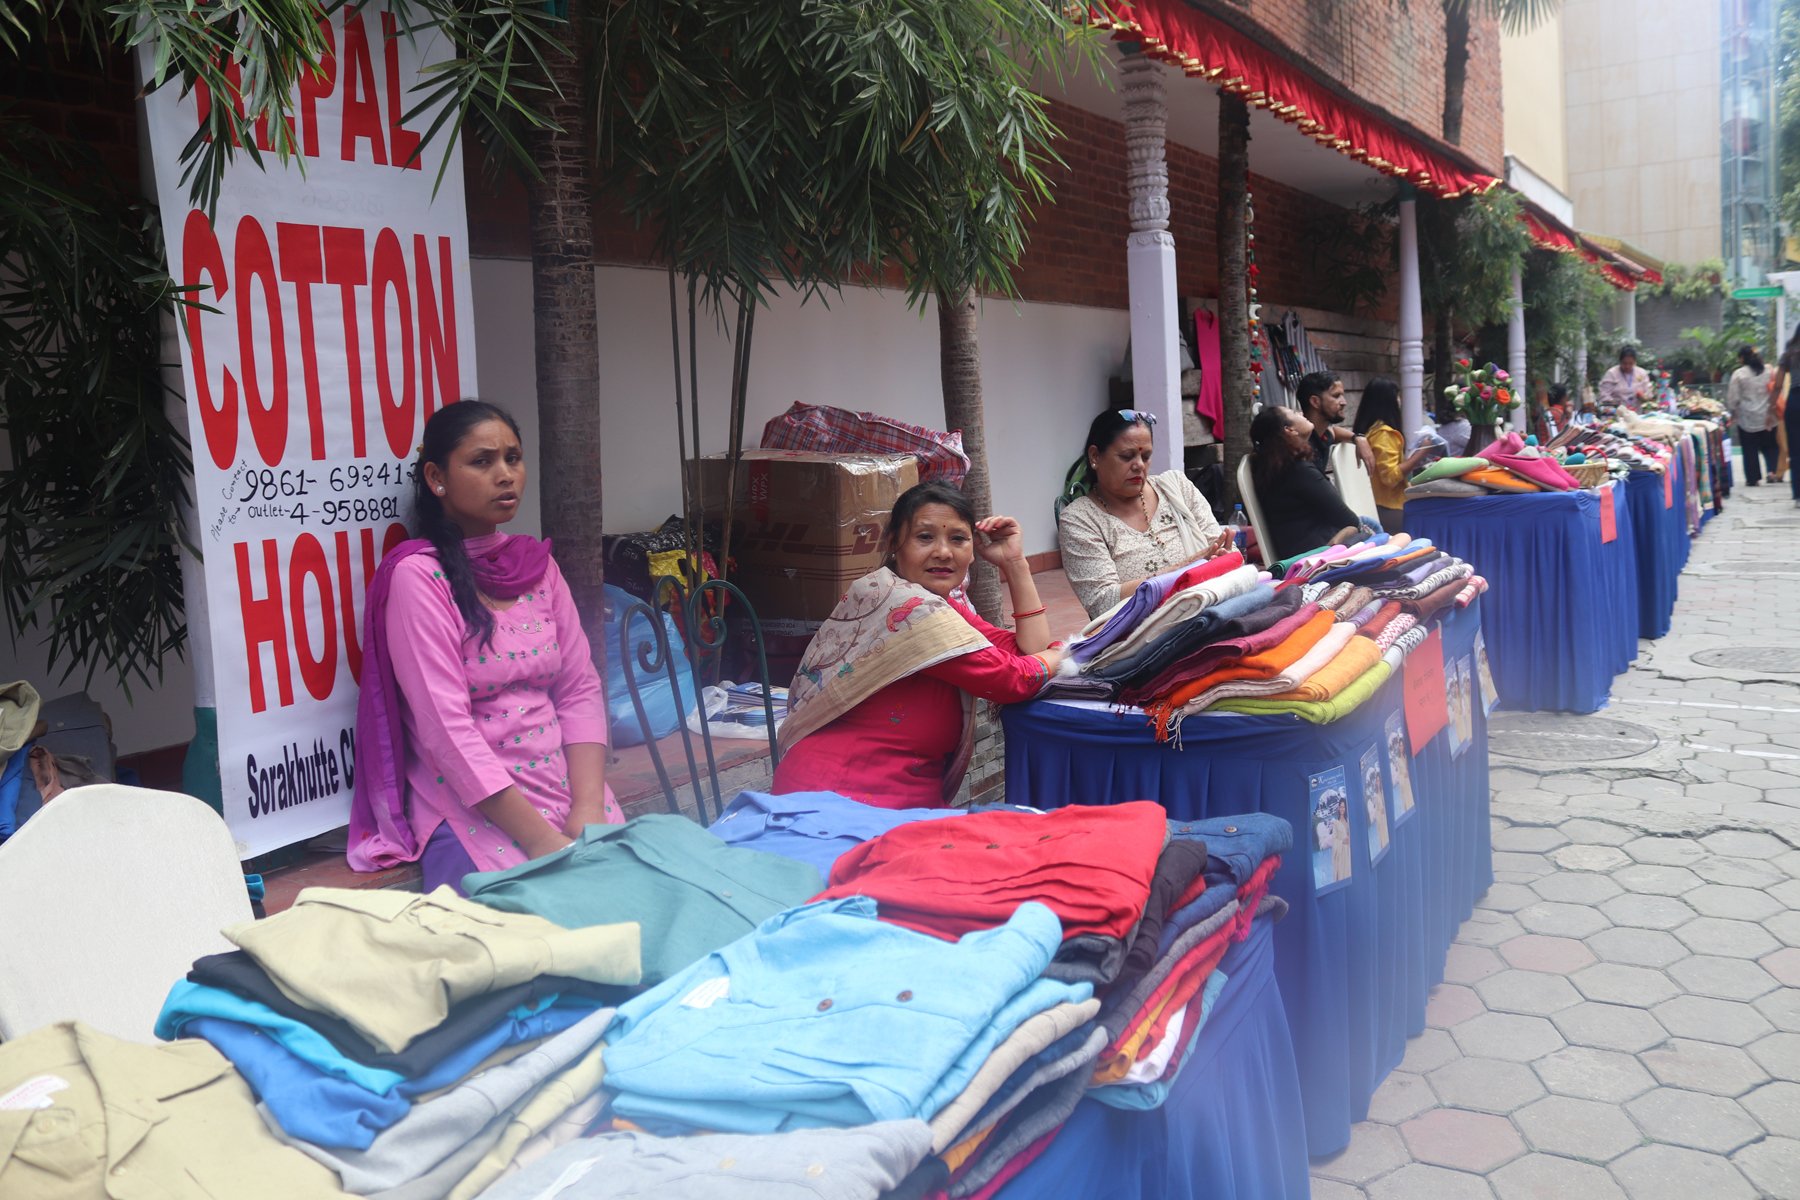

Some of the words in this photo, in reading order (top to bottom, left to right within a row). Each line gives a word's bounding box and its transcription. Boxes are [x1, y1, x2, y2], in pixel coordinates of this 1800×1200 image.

[182, 208, 461, 471] COTTON
[210, 506, 228, 542] Please
[222, 459, 248, 500] Contact
[759, 472, 769, 501] WPX
[233, 522, 411, 714] HOU
[246, 736, 340, 819] Sorakhutte
